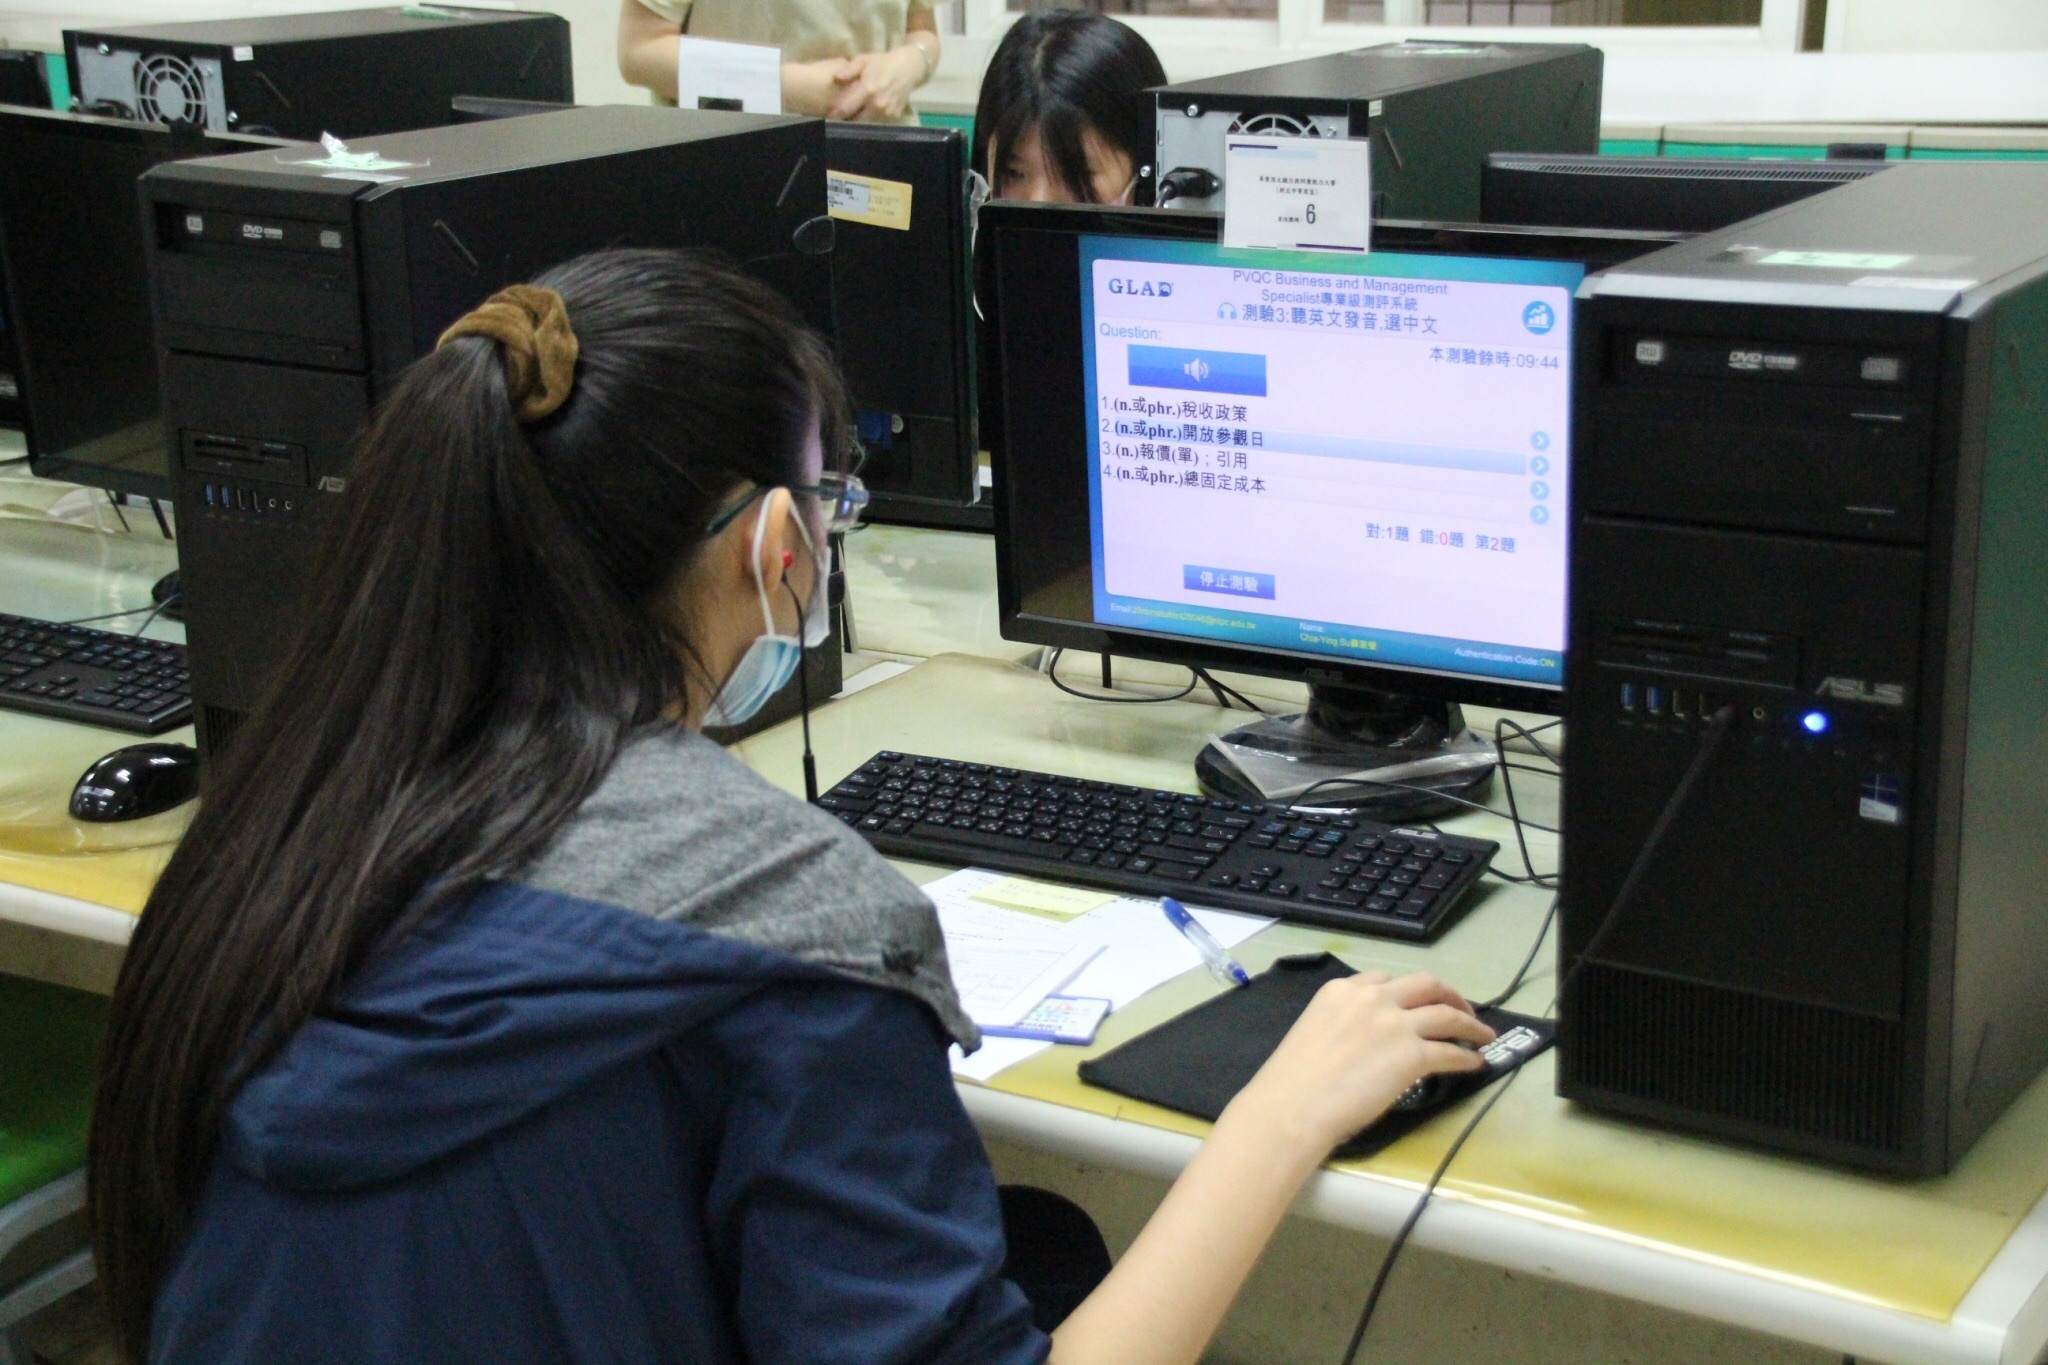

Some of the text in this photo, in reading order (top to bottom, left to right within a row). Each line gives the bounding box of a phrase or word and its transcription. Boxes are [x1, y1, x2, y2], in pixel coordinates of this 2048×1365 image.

[1306, 203, 1316, 224] 6
[243, 224, 263, 234] DVD
[1108, 278, 1172, 297] GLAD
[1233, 270, 1448, 295] PVQC Business and Management
[1100, 322, 1161, 340] Question:
[1729, 351, 1763, 363] DVD
[1366, 522, 1410, 542] 對:1題
[1475, 534, 1516, 553] 第2題
[1200, 571, 1258, 592] 停止測驗
[1455, 648, 1513, 662] Authentication
[1815, 676, 1904, 704] ASUS
[1390, 828, 1438, 839] ASUS
